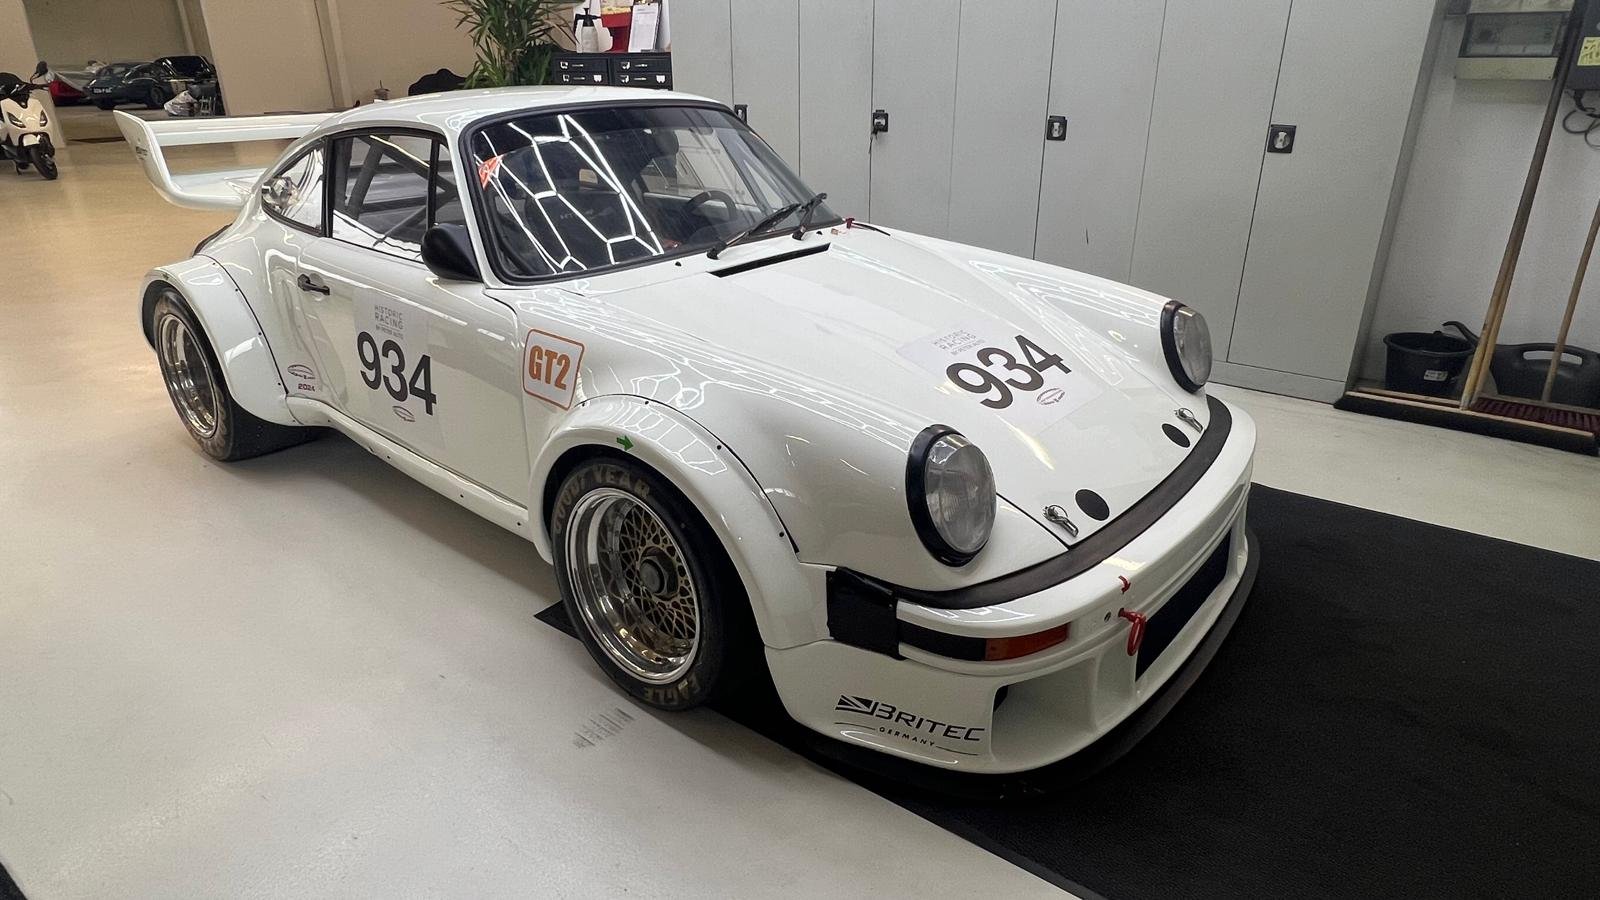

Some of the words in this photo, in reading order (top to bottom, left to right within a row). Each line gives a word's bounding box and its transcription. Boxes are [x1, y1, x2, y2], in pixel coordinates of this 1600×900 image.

[374, 304, 403, 320] HISTORIC
[374, 312, 404, 330] RACING
[357, 331, 437, 416] 934
[528, 345, 571, 391] GT2
[946, 334, 1072, 410] 934
[872, 701, 985, 742] BRITEC
[879, 726, 936, 747] GERMANY
